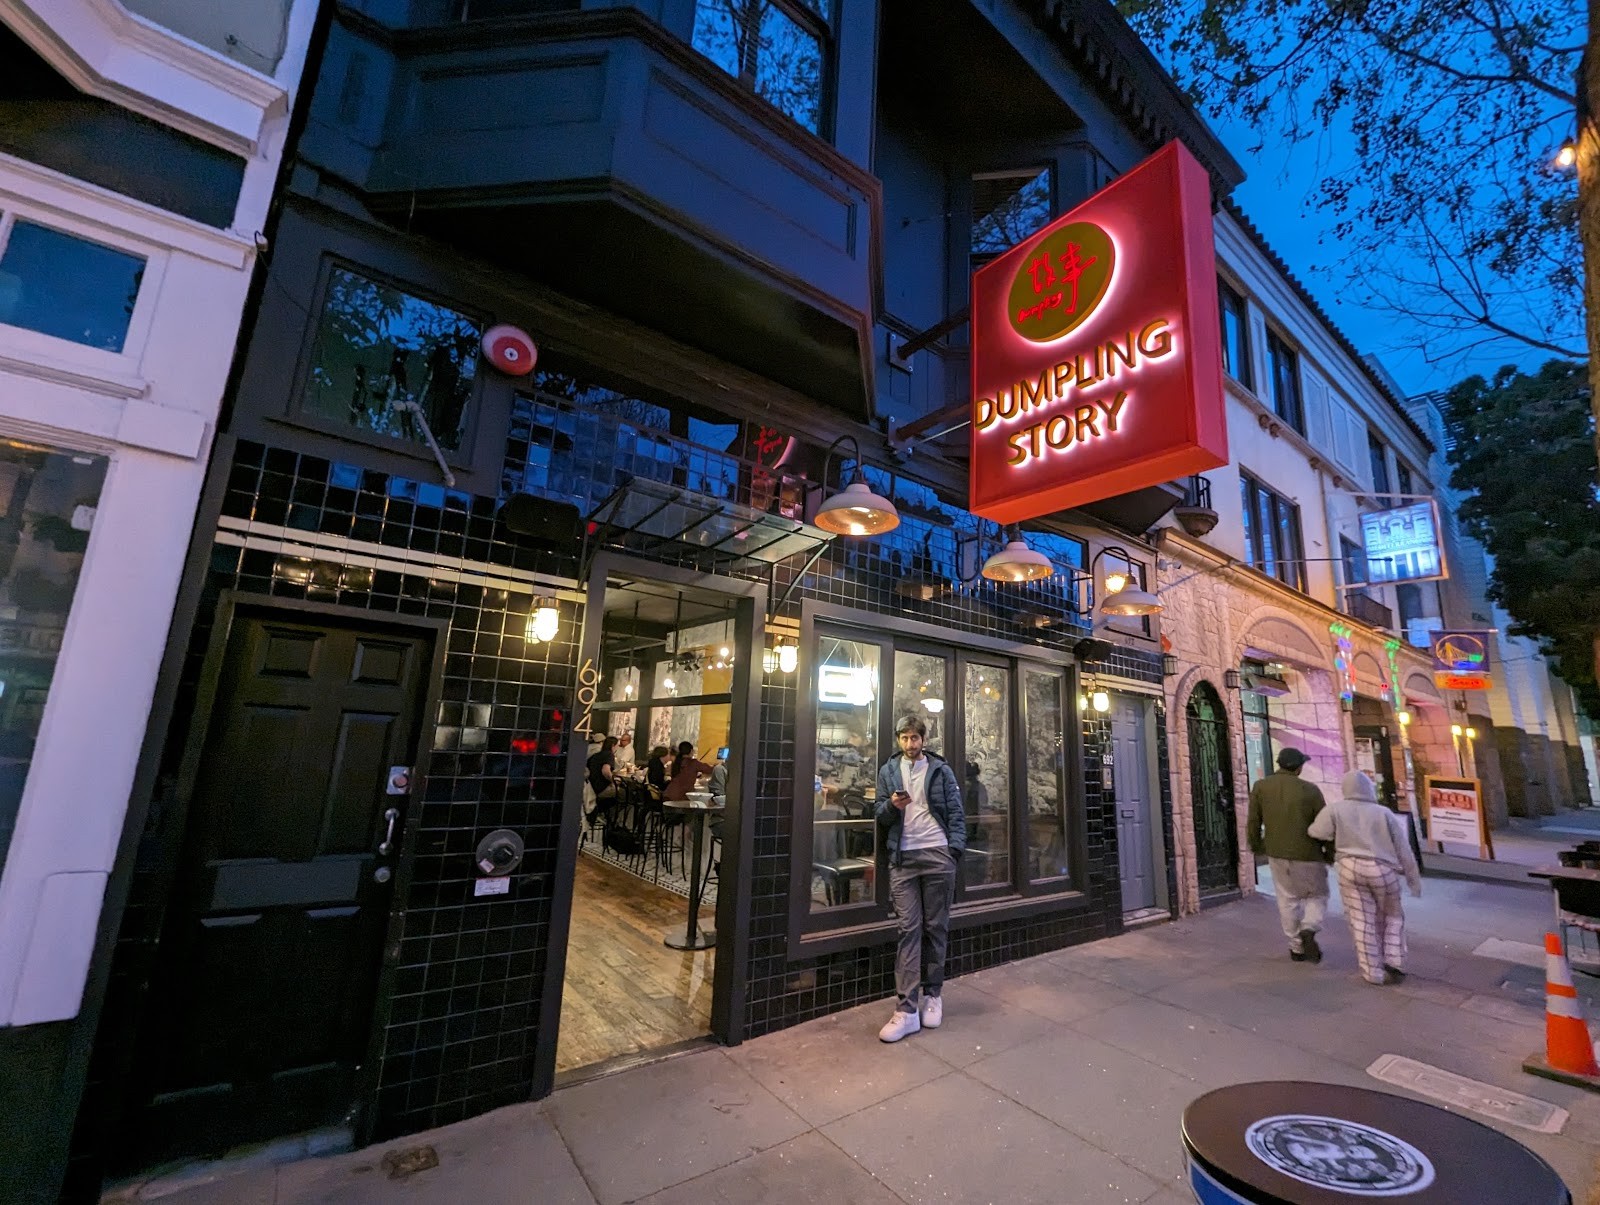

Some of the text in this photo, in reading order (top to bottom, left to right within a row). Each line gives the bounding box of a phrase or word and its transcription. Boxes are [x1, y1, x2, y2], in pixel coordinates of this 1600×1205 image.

[974, 318, 1172, 431] DUMPLING
[1007, 391, 1128, 466] STORY
[573, 658, 598, 741] 694
[1103, 754, 1114, 765] 692
